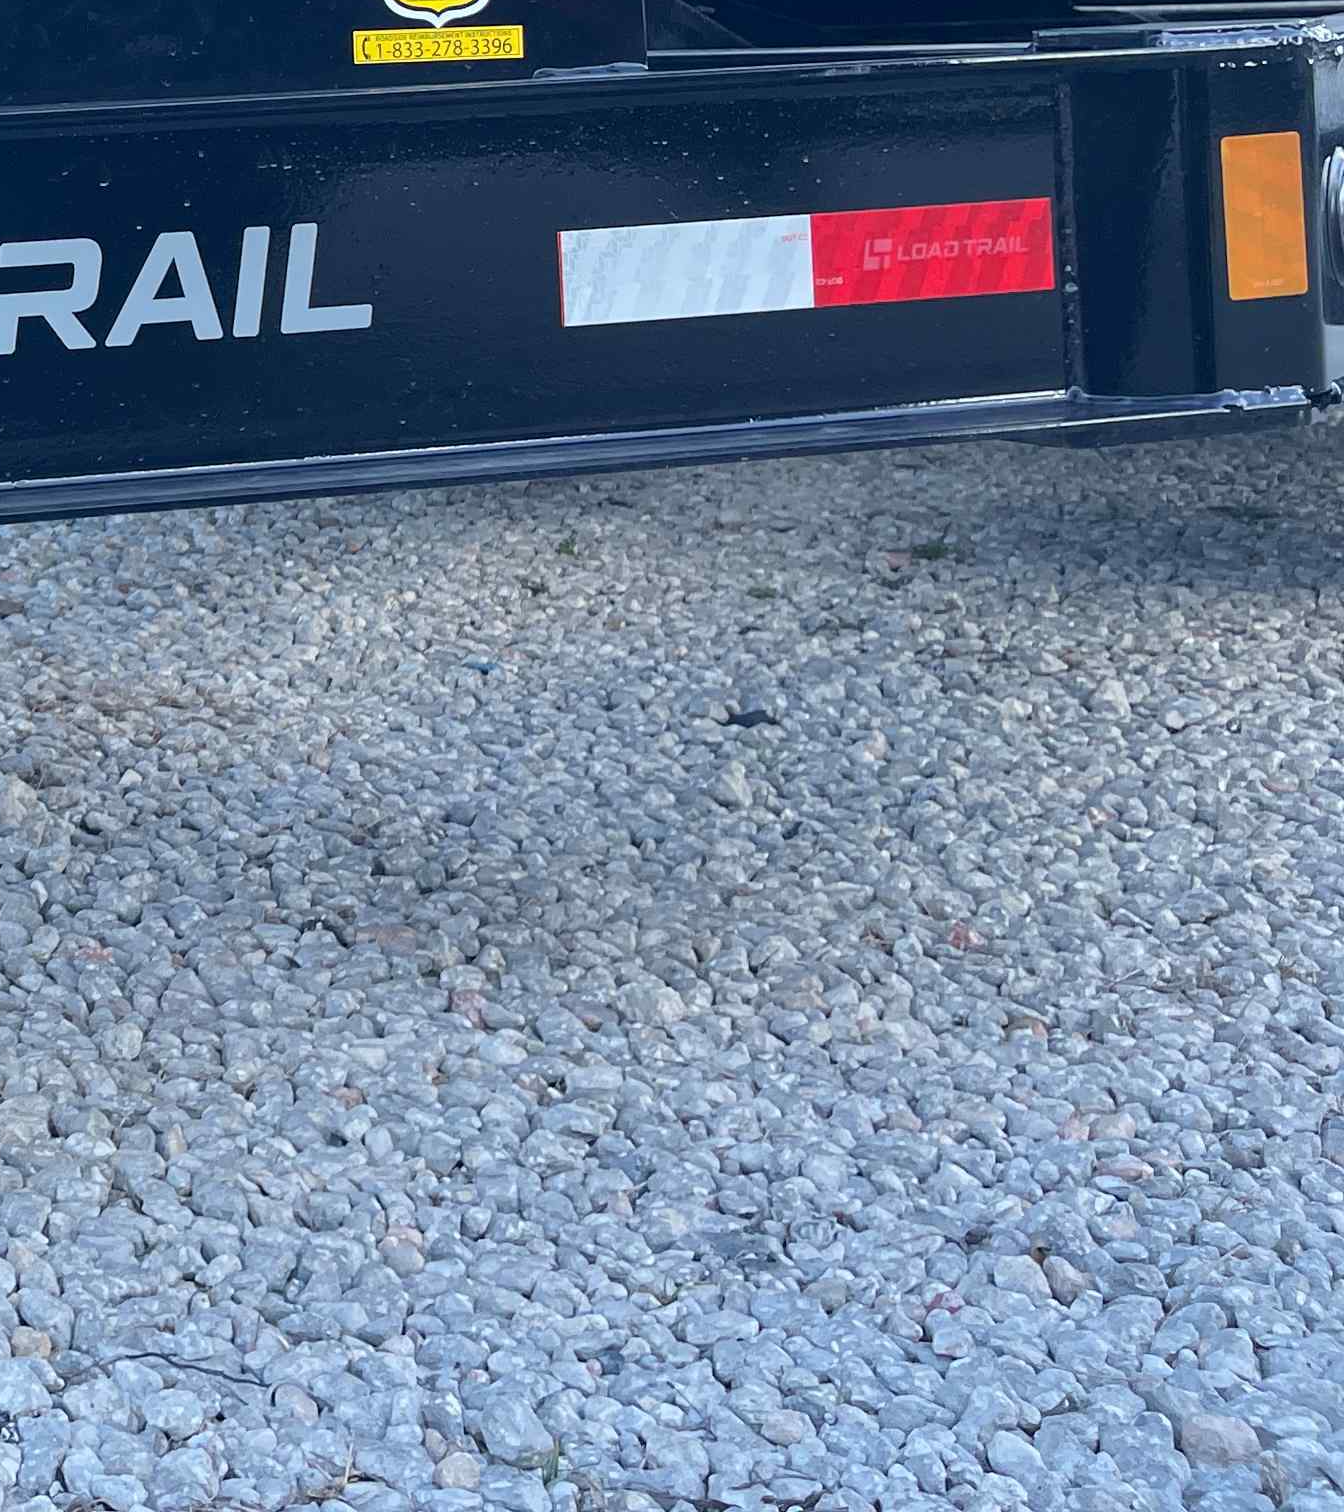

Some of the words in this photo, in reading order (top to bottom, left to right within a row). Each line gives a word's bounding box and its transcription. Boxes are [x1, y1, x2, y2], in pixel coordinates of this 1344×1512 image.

[376, 38, 513, 60] 1-833-278-3396
[897, 238, 959, 261] LOAD
[963, 235, 1030, 257] TRAIL
